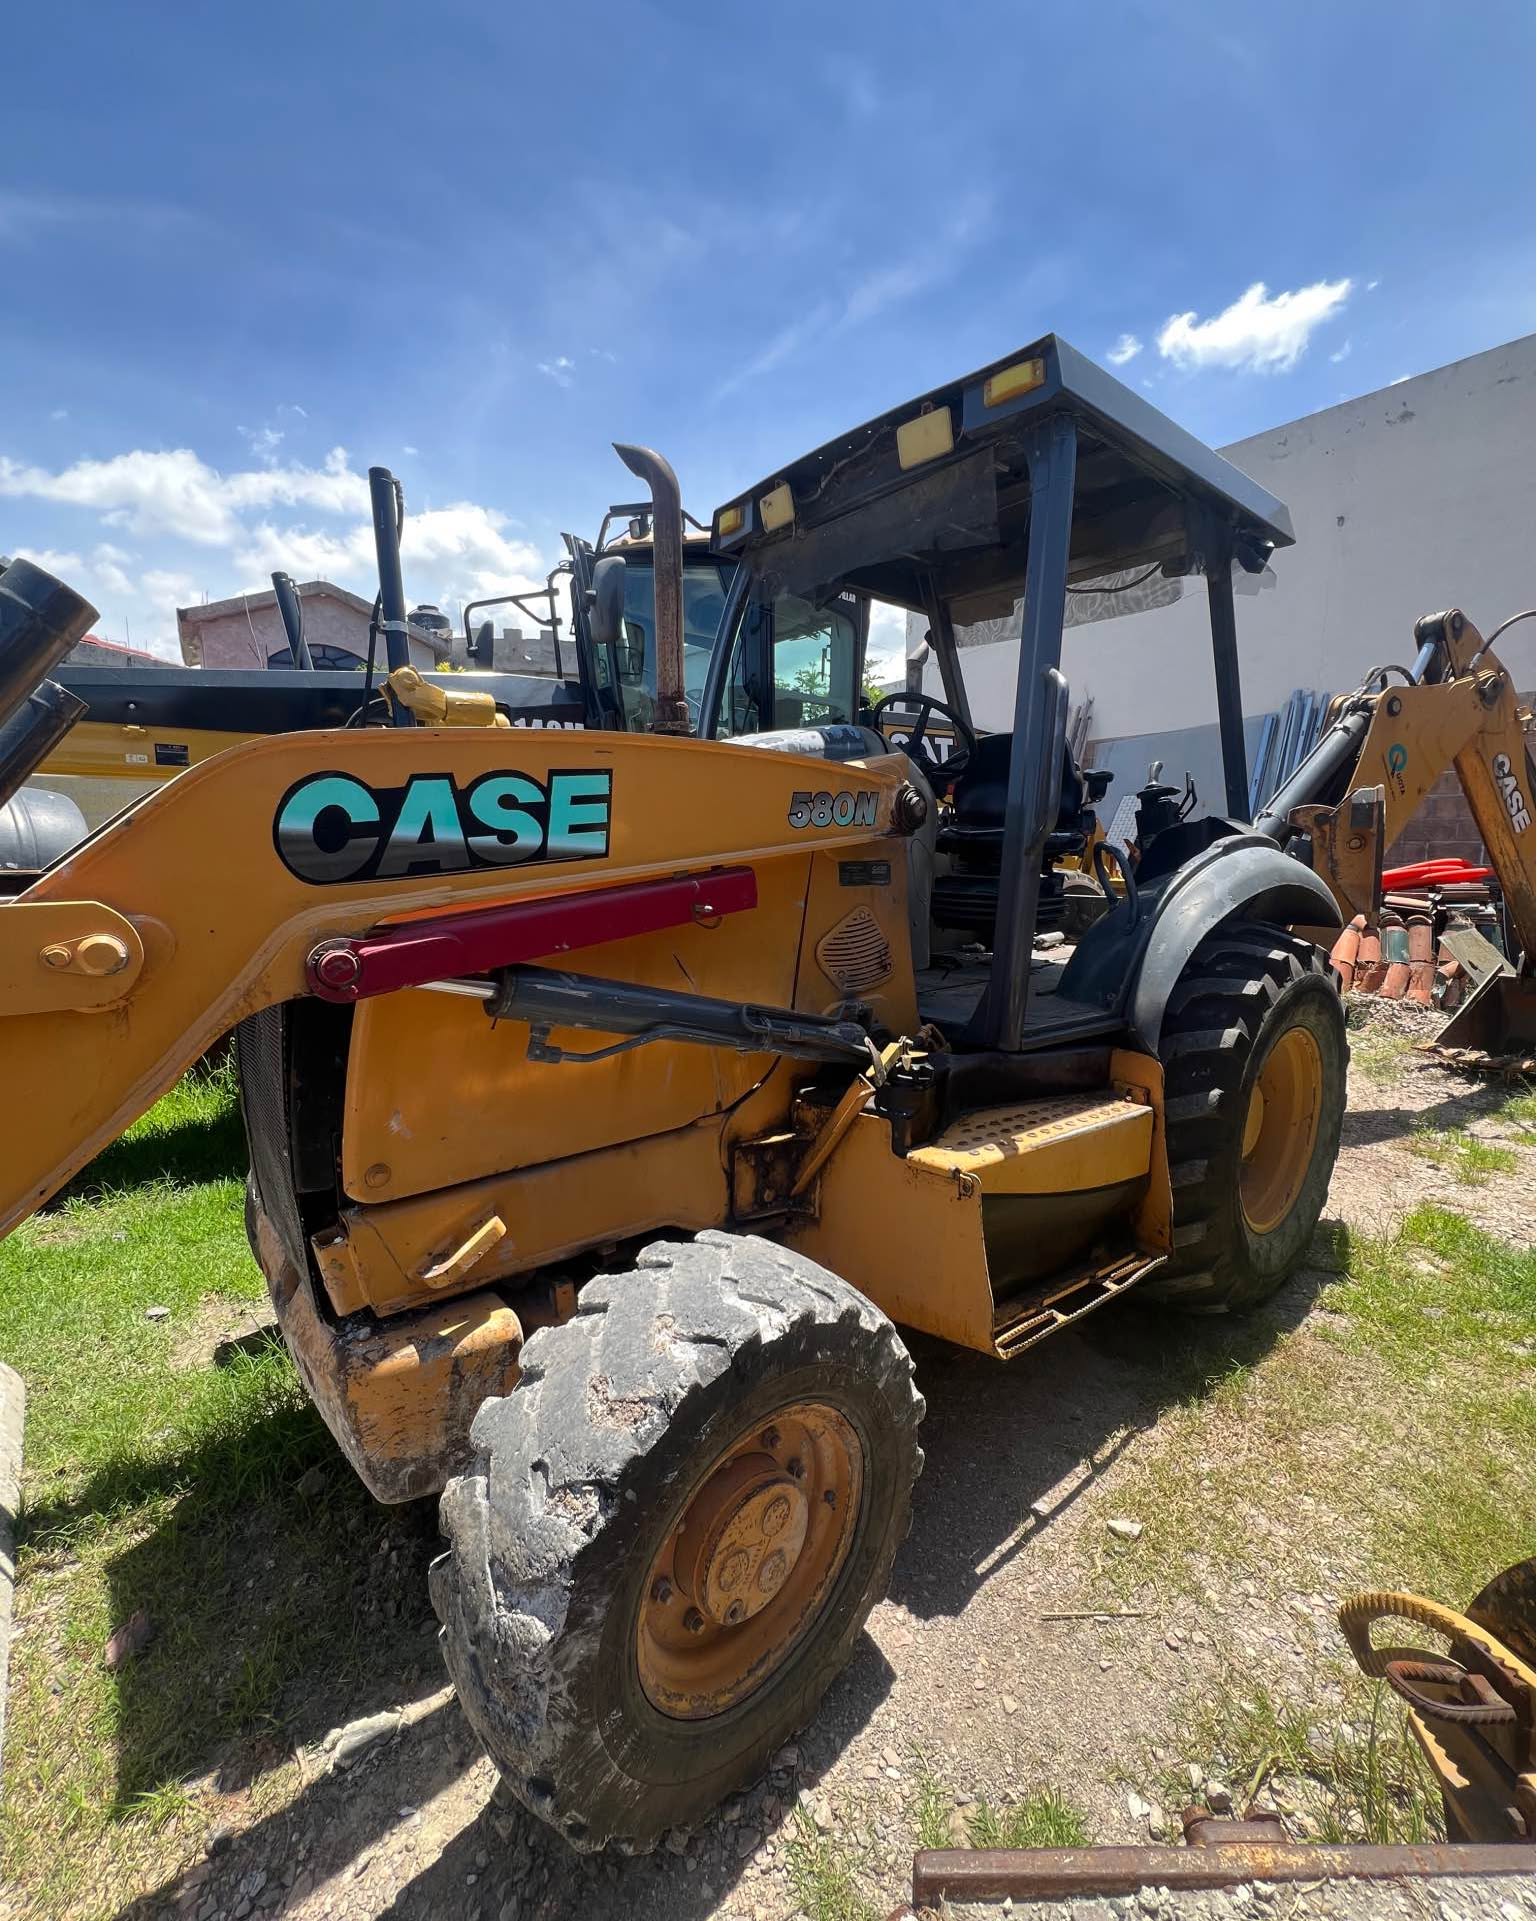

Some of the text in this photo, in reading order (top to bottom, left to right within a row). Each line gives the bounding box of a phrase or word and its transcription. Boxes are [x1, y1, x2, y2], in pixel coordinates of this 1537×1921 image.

[275, 769, 612, 884] CASE
[788, 791, 879, 828] 580N
[1492, 753, 1532, 833] CASE
